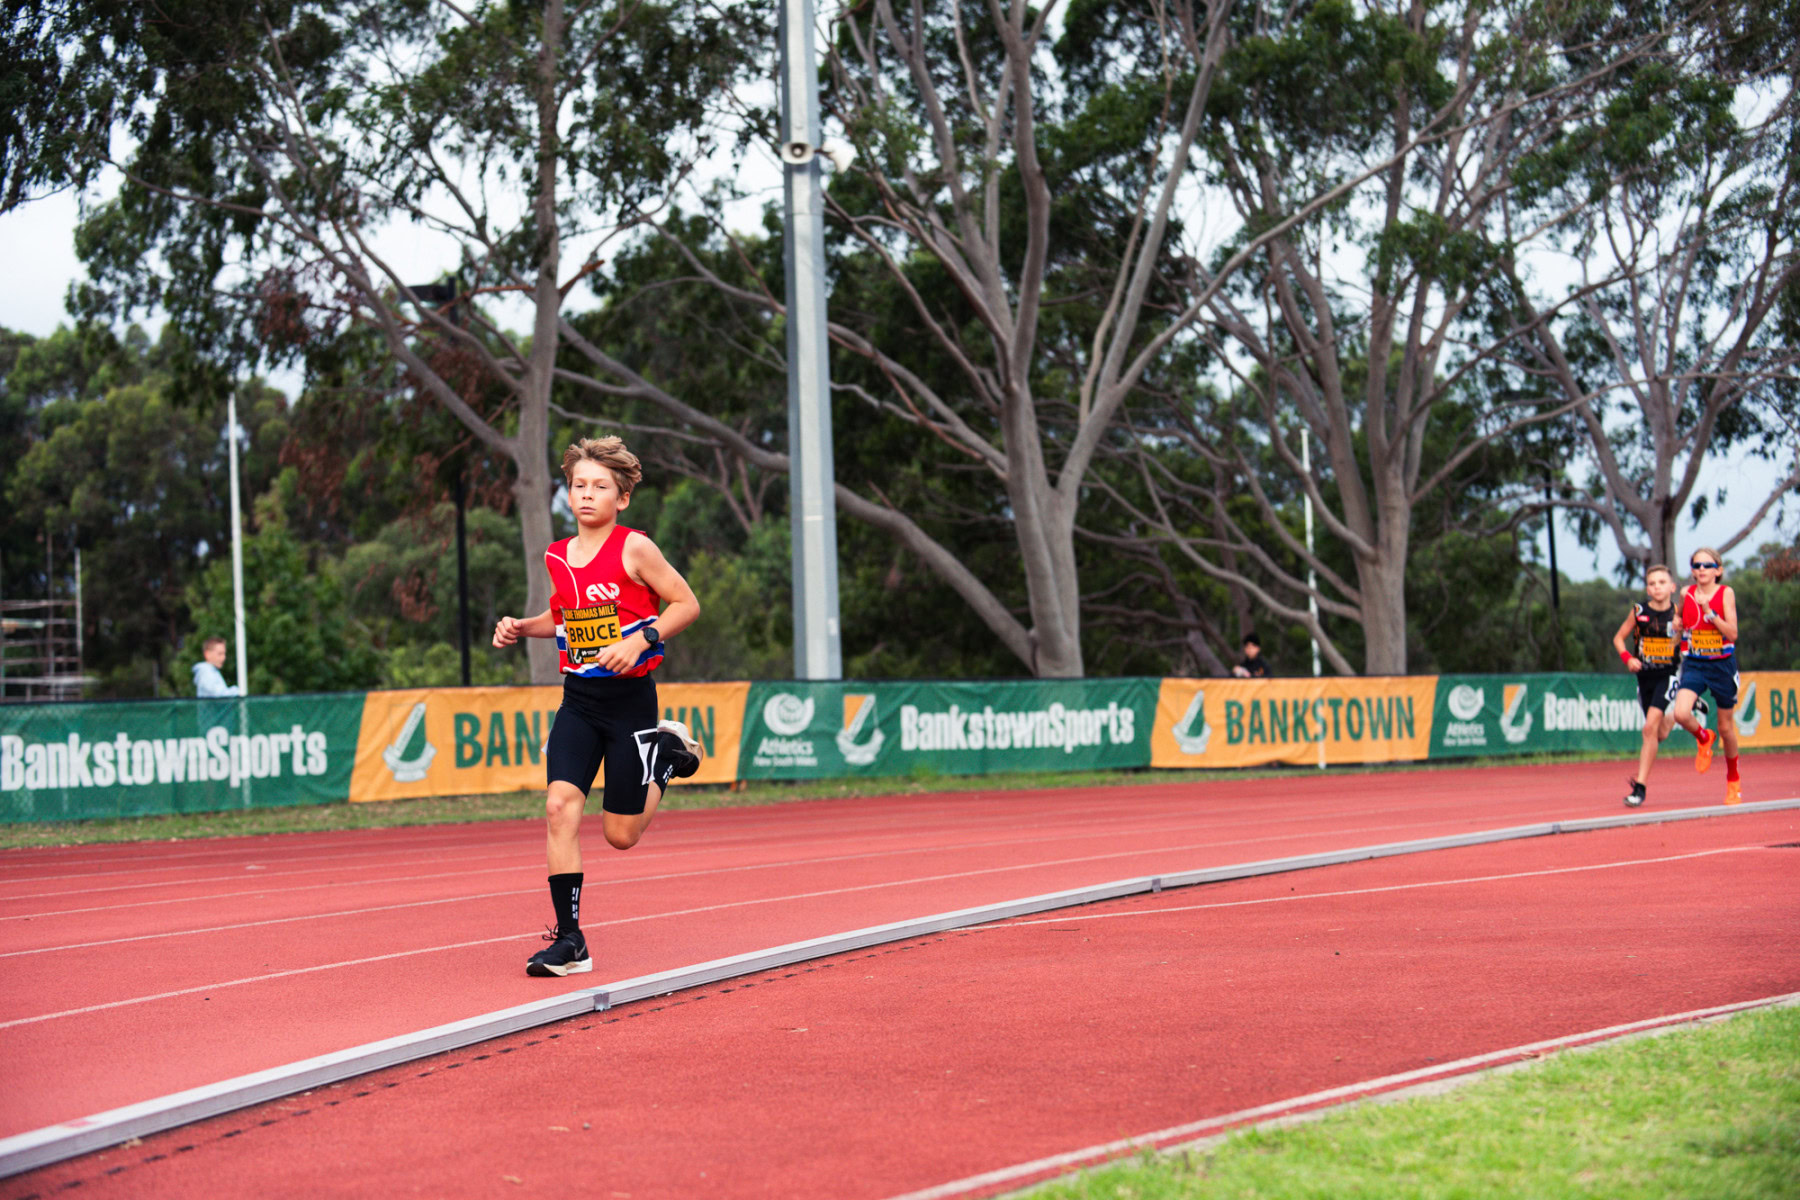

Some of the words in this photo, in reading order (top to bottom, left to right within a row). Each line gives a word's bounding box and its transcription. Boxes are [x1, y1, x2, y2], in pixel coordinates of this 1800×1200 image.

[569, 623, 617, 642] BRUCE
[575, 606, 598, 618] THOMAS
[598, 604, 615, 617] MILE
[901, 702, 1135, 753] BankstownSports
[1225, 696, 1415, 745] BANKSTOWN
[0, 724, 328, 791] BankstownSports
[638, 730, 658, 782] 7
